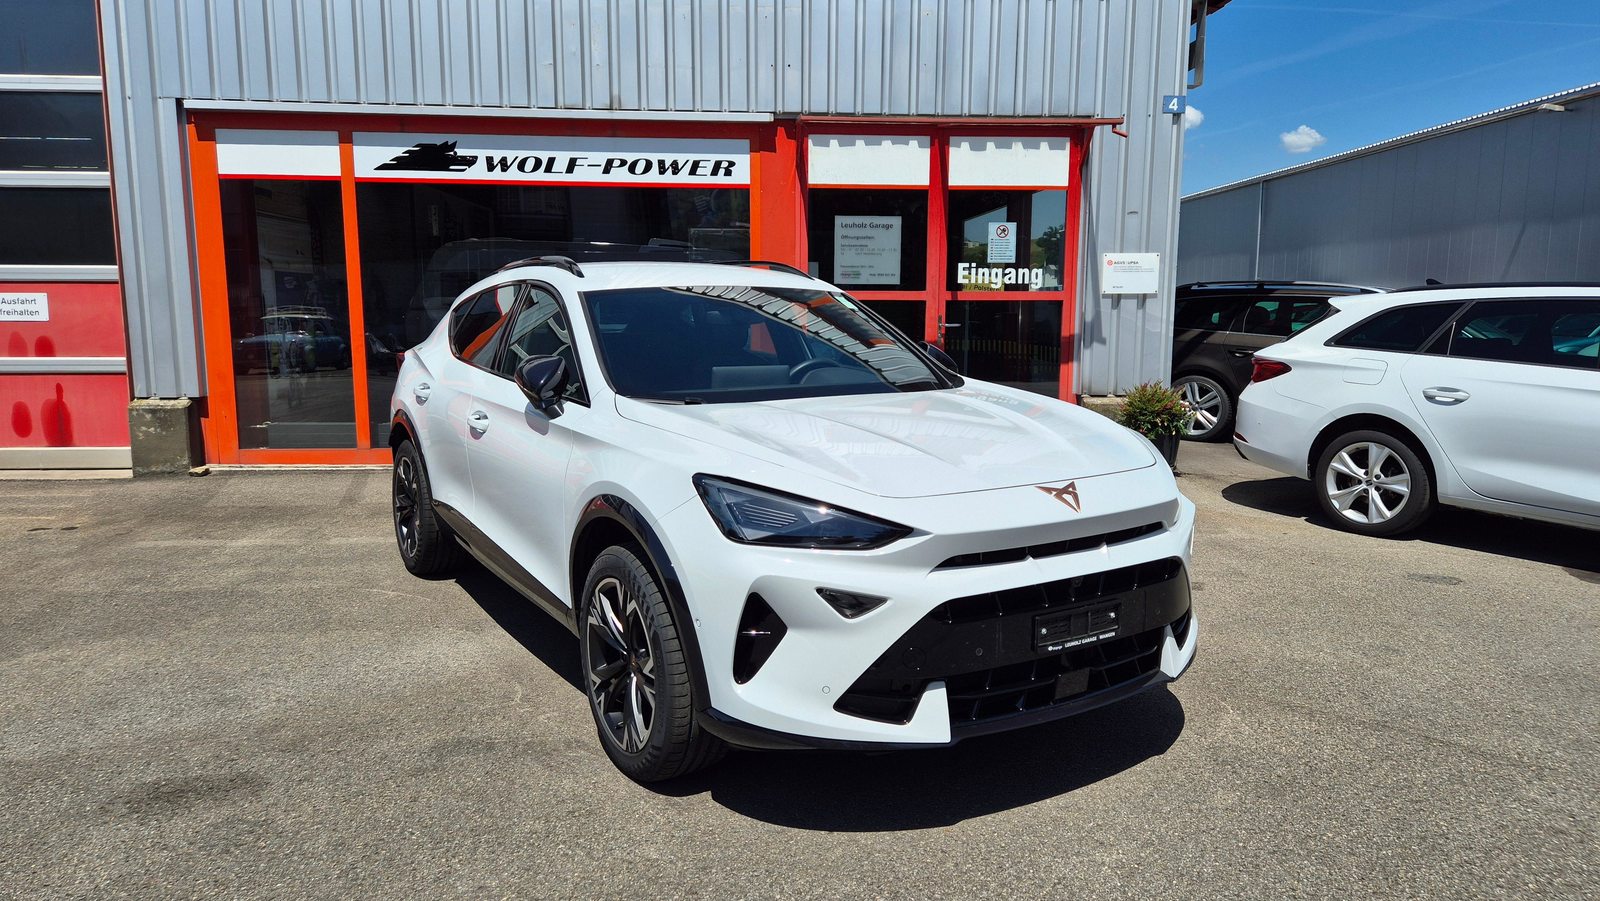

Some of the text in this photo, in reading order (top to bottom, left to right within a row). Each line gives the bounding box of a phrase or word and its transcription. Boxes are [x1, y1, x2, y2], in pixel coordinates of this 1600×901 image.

[1168, 97, 1179, 111] 4
[485, 155, 737, 177] WOLF-POWER
[869, 222, 894, 230] Garage
[957, 262, 1043, 289] Eingang
